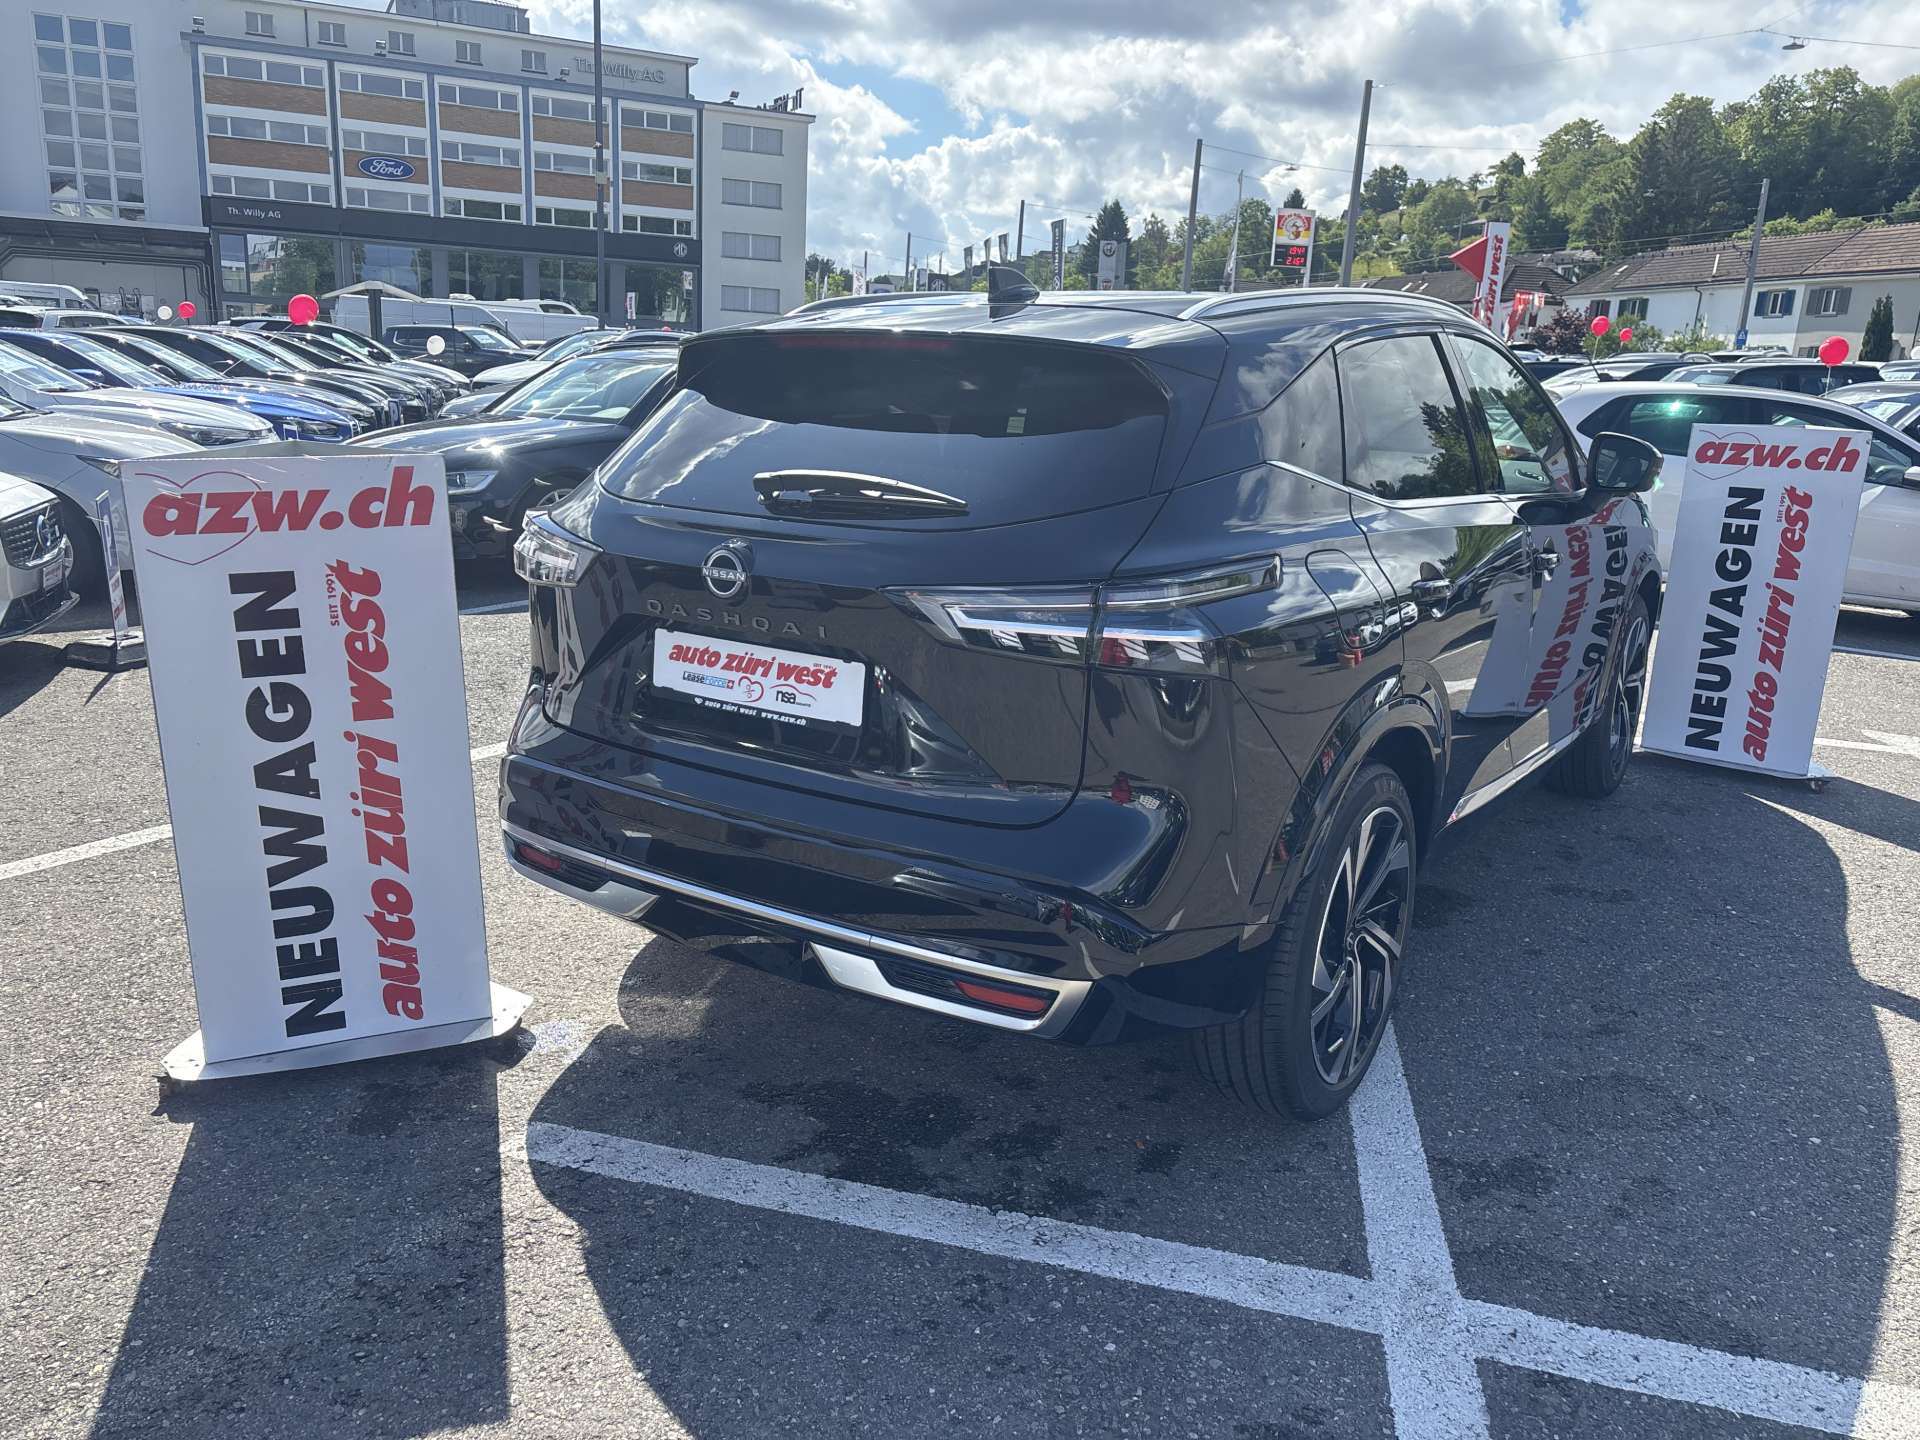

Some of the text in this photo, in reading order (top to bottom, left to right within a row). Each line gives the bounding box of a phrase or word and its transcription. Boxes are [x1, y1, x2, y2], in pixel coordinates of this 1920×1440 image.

[602, 61, 637, 82] Willy
[642, 66, 665, 83] AG
[369, 159, 404, 176] Ford
[227, 206, 281, 219] Th. Willy AG
[1490, 234, 1504, 275] west
[1694, 437, 1861, 473] azw.ch
[142, 465, 436, 537] azw.ch
[702, 567, 745, 581] NISSAN
[326, 572, 341, 627] SEIT 1991
[647, 599, 828, 639] QASHQAI
[1684, 486, 1765, 752] NEUWAGEN
[1743, 485, 1814, 762] auto züri west
[668, 644, 839, 689] auto züri west
[704, 700, 721, 709] auto
[739, 707, 757, 716] west
[775, 690, 797, 704] nsa
[228, 570, 348, 1038] NEUWAGEN
[324, 558, 425, 1022] auto züri west
